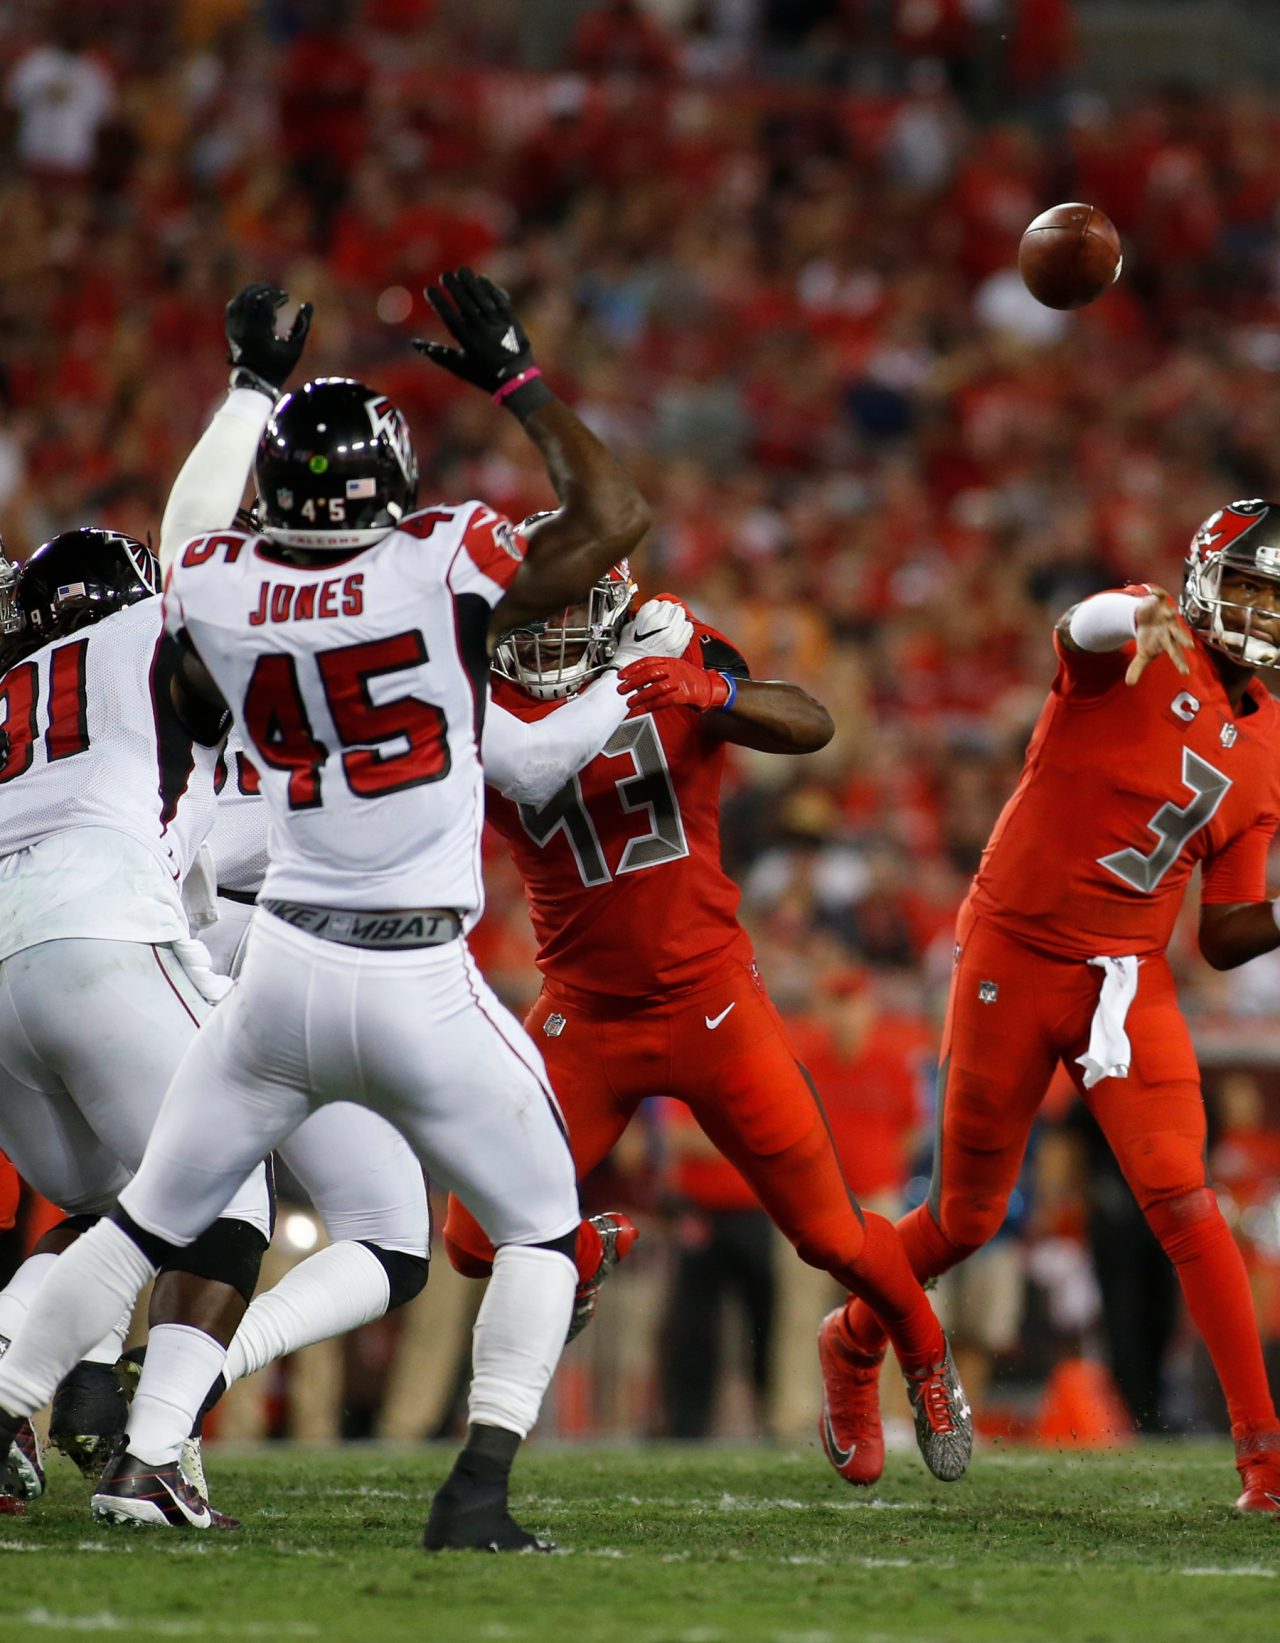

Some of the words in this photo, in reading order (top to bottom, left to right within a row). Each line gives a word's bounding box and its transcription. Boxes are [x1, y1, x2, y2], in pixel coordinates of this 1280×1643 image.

[301, 498, 345, 522] 45
[249, 573, 364, 626] JONES
[243, 628, 451, 811] 45
[1170, 691, 1200, 722] C
[1097, 745, 1233, 893] 3
